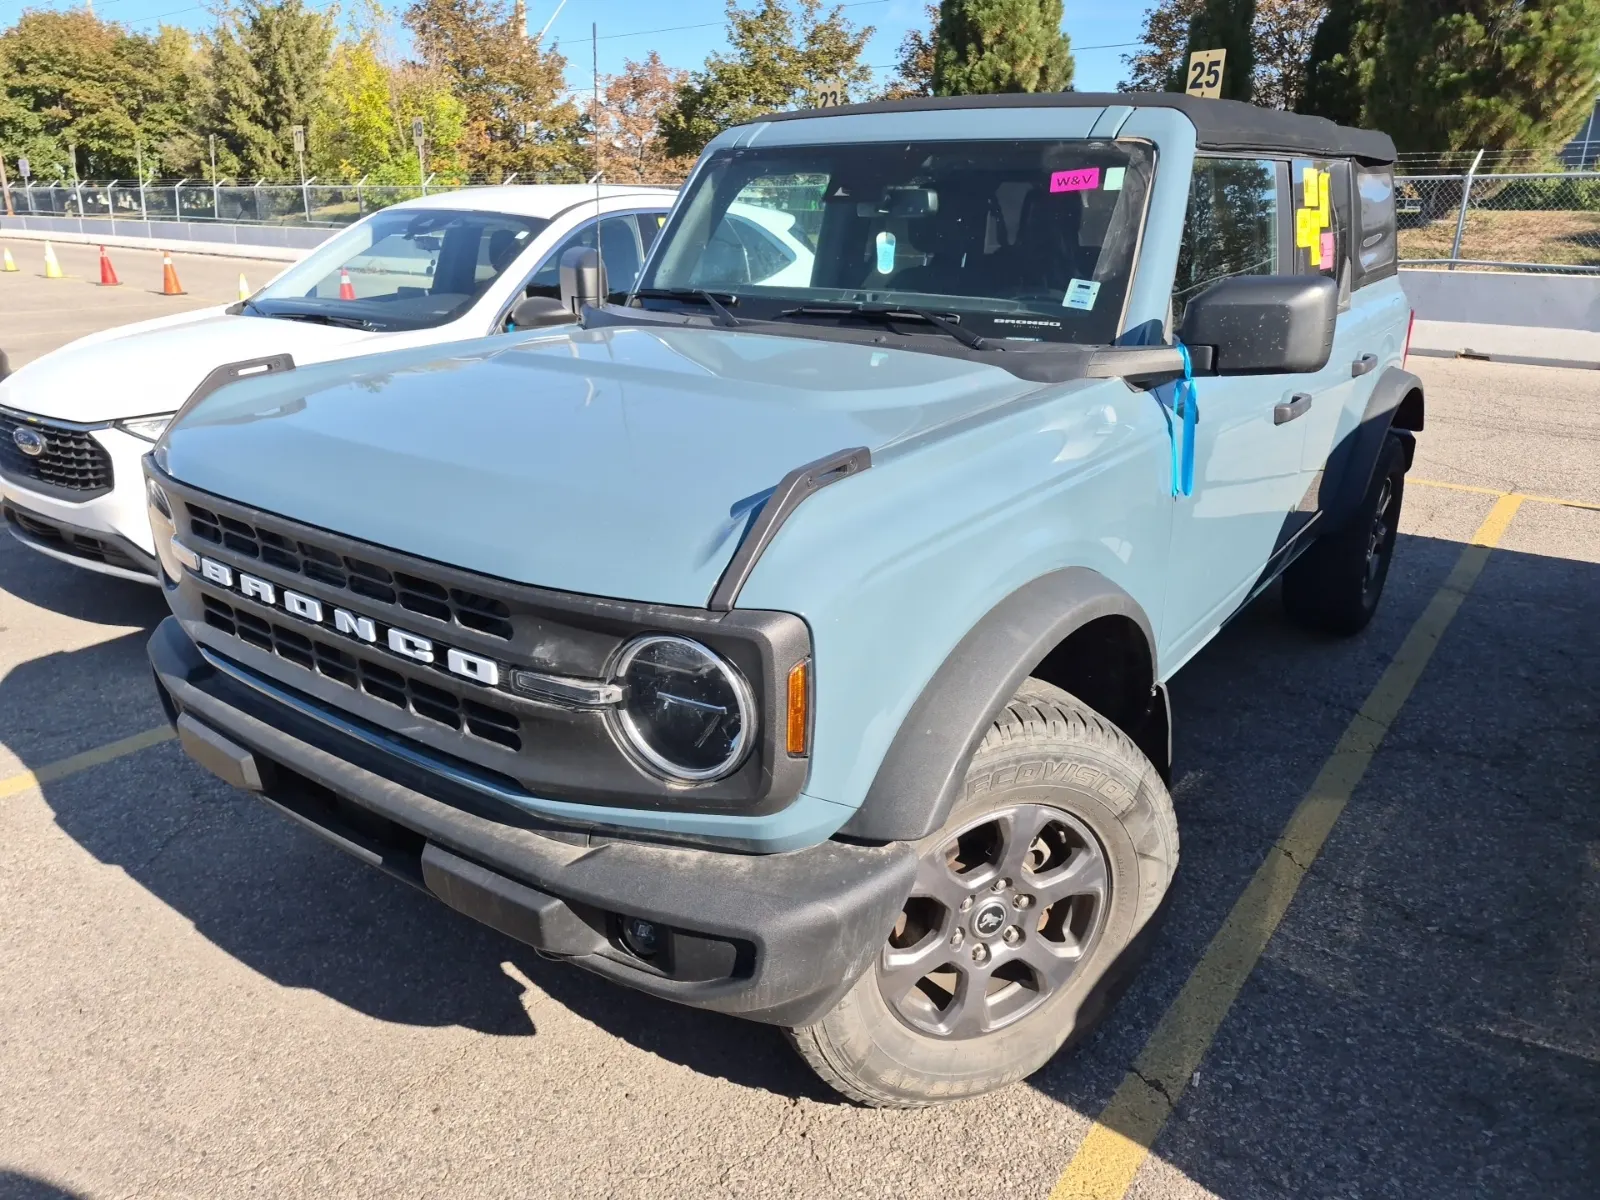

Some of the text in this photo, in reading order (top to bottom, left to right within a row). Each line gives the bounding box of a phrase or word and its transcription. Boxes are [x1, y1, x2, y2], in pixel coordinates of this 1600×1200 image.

[1189, 60, 1221, 89] 25
[820, 91, 838, 108] 23
[294, 130, 303, 143] 17
[414, 121, 423, 137] 19
[1056, 174, 1093, 187] W&V
[201, 556, 499, 686] BRONCO
[965, 760, 1138, 817] ECOVISION
